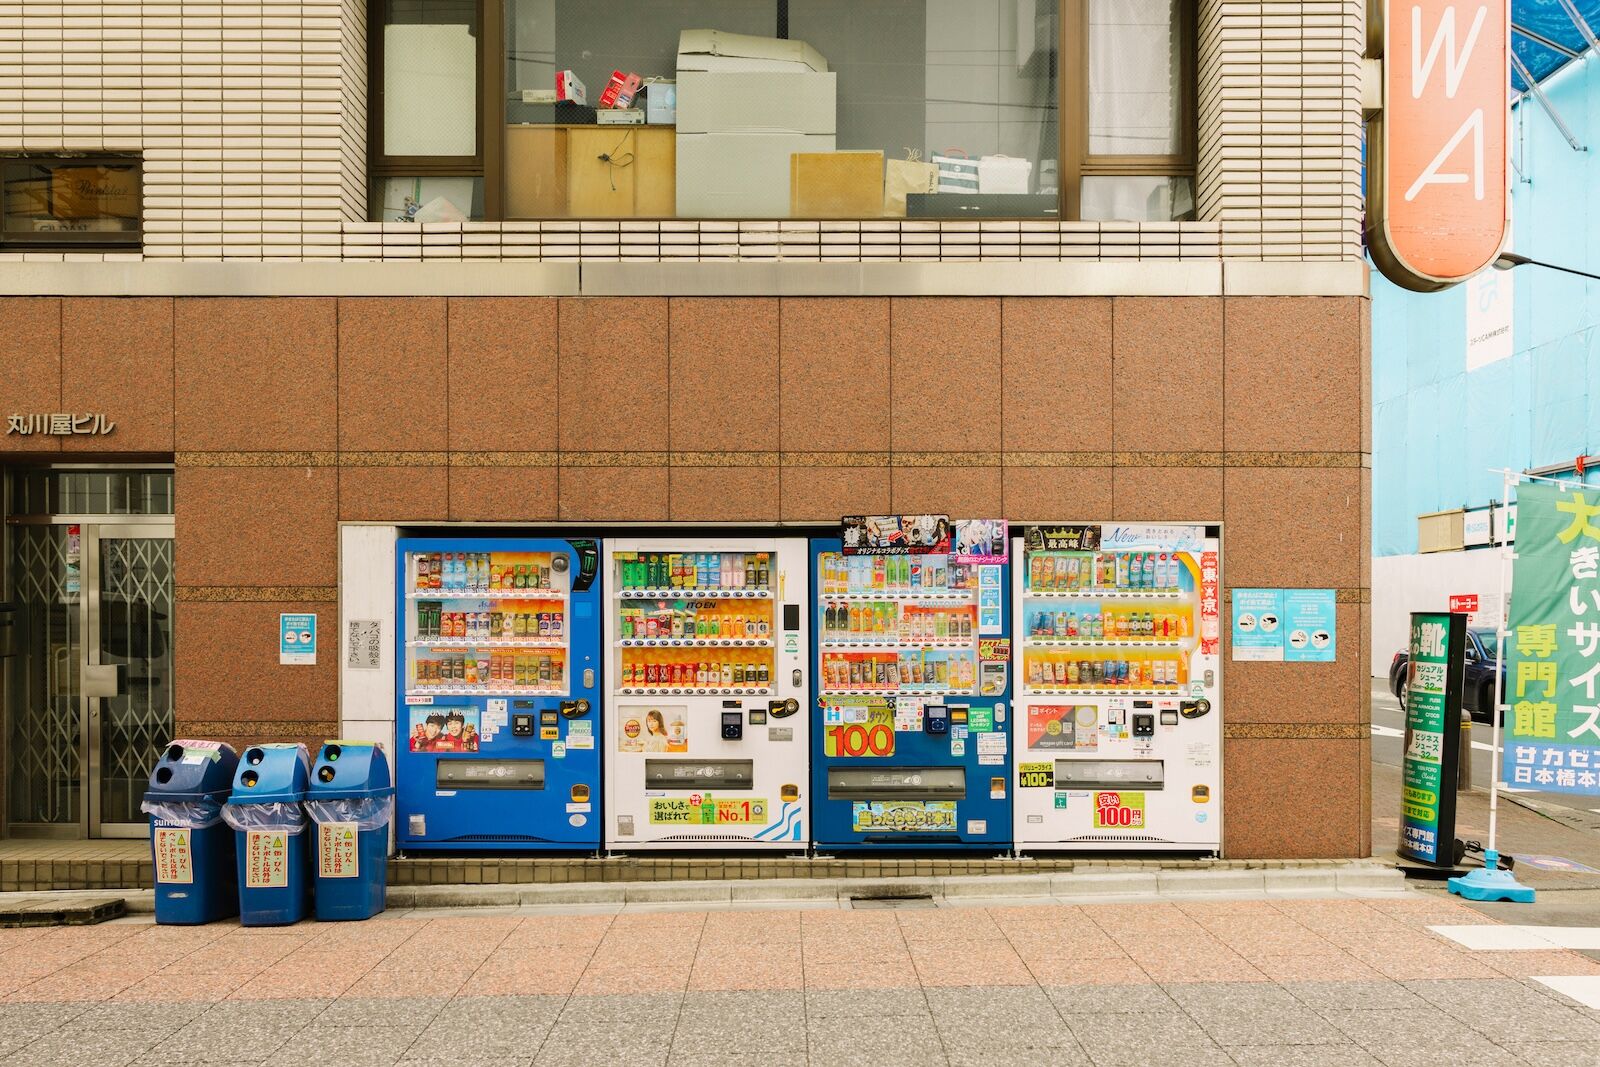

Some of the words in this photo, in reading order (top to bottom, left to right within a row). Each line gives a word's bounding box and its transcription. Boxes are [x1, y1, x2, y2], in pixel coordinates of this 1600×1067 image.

[6, 413, 116, 435] 丸川屋ビル
[1048, 538, 1079, 549] 最高峰
[1104, 527, 1140, 543] New
[1556, 492, 1600, 739] 大きいサイズ
[1420, 622, 1446, 657] 靴
[1416, 665, 1443, 674] カジュアル
[1420, 674, 1443, 682] シューズ
[1513, 624, 1558, 738] 専門館
[829, 724, 894, 757] 100
[1415, 734, 1439, 743] ビジネス
[1415, 742, 1439, 752] シューズ
[1514, 767, 1600, 788] 日本橋本
[654, 801, 689, 810] おいしさで
[1098, 794, 1119, 805] 安い
[159, 831, 169, 879] 捨てないでください
[169, 832, 177, 879] ペットボトル以外は
[252, 834, 260, 883] 捨てないでください
[263, 834, 271, 883] ペットボトル以外は
